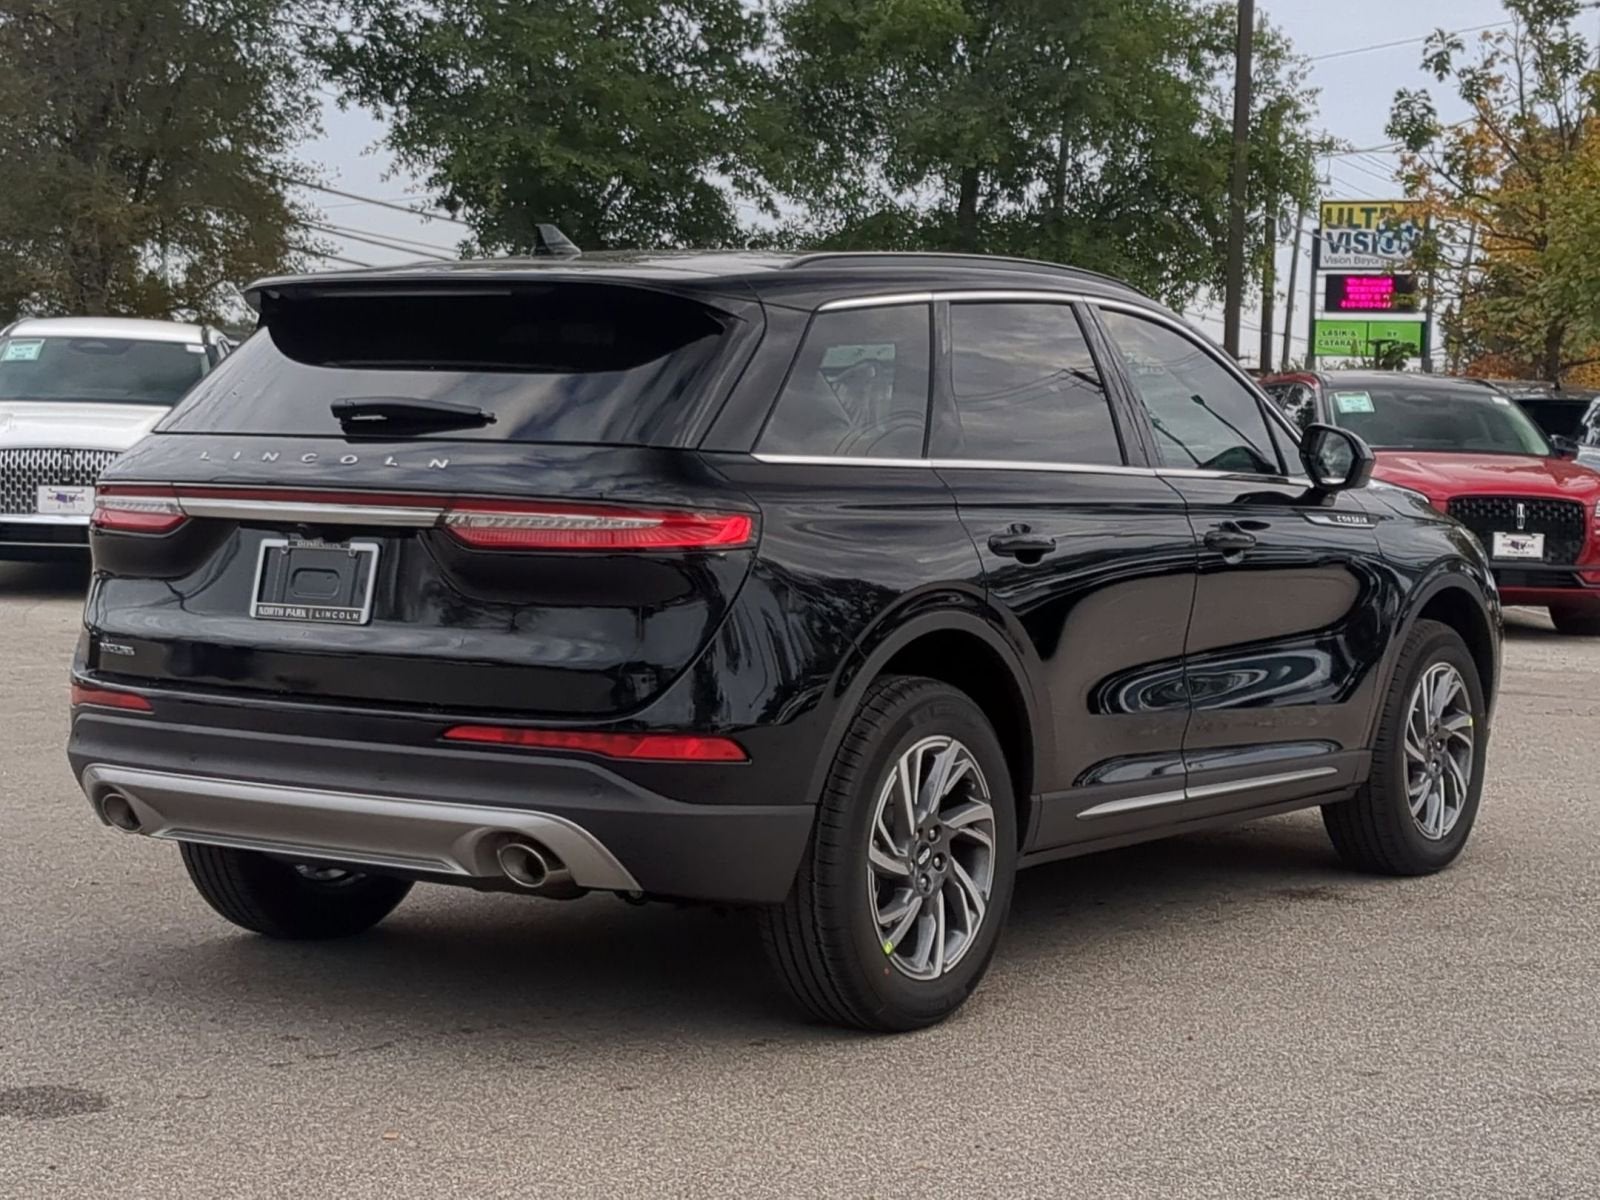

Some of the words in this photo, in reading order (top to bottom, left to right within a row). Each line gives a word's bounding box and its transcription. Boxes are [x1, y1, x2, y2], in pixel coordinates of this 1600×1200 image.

[1325, 207, 1420, 229] ULT
[1324, 255, 1351, 265] Vision
[1318, 339, 1364, 347] CATARAT
[199, 451, 449, 469] LINCOLN
[257, 606, 284, 617] NORTH
[285, 607, 306, 618] PARK
[315, 609, 360, 620] LINCOLN
